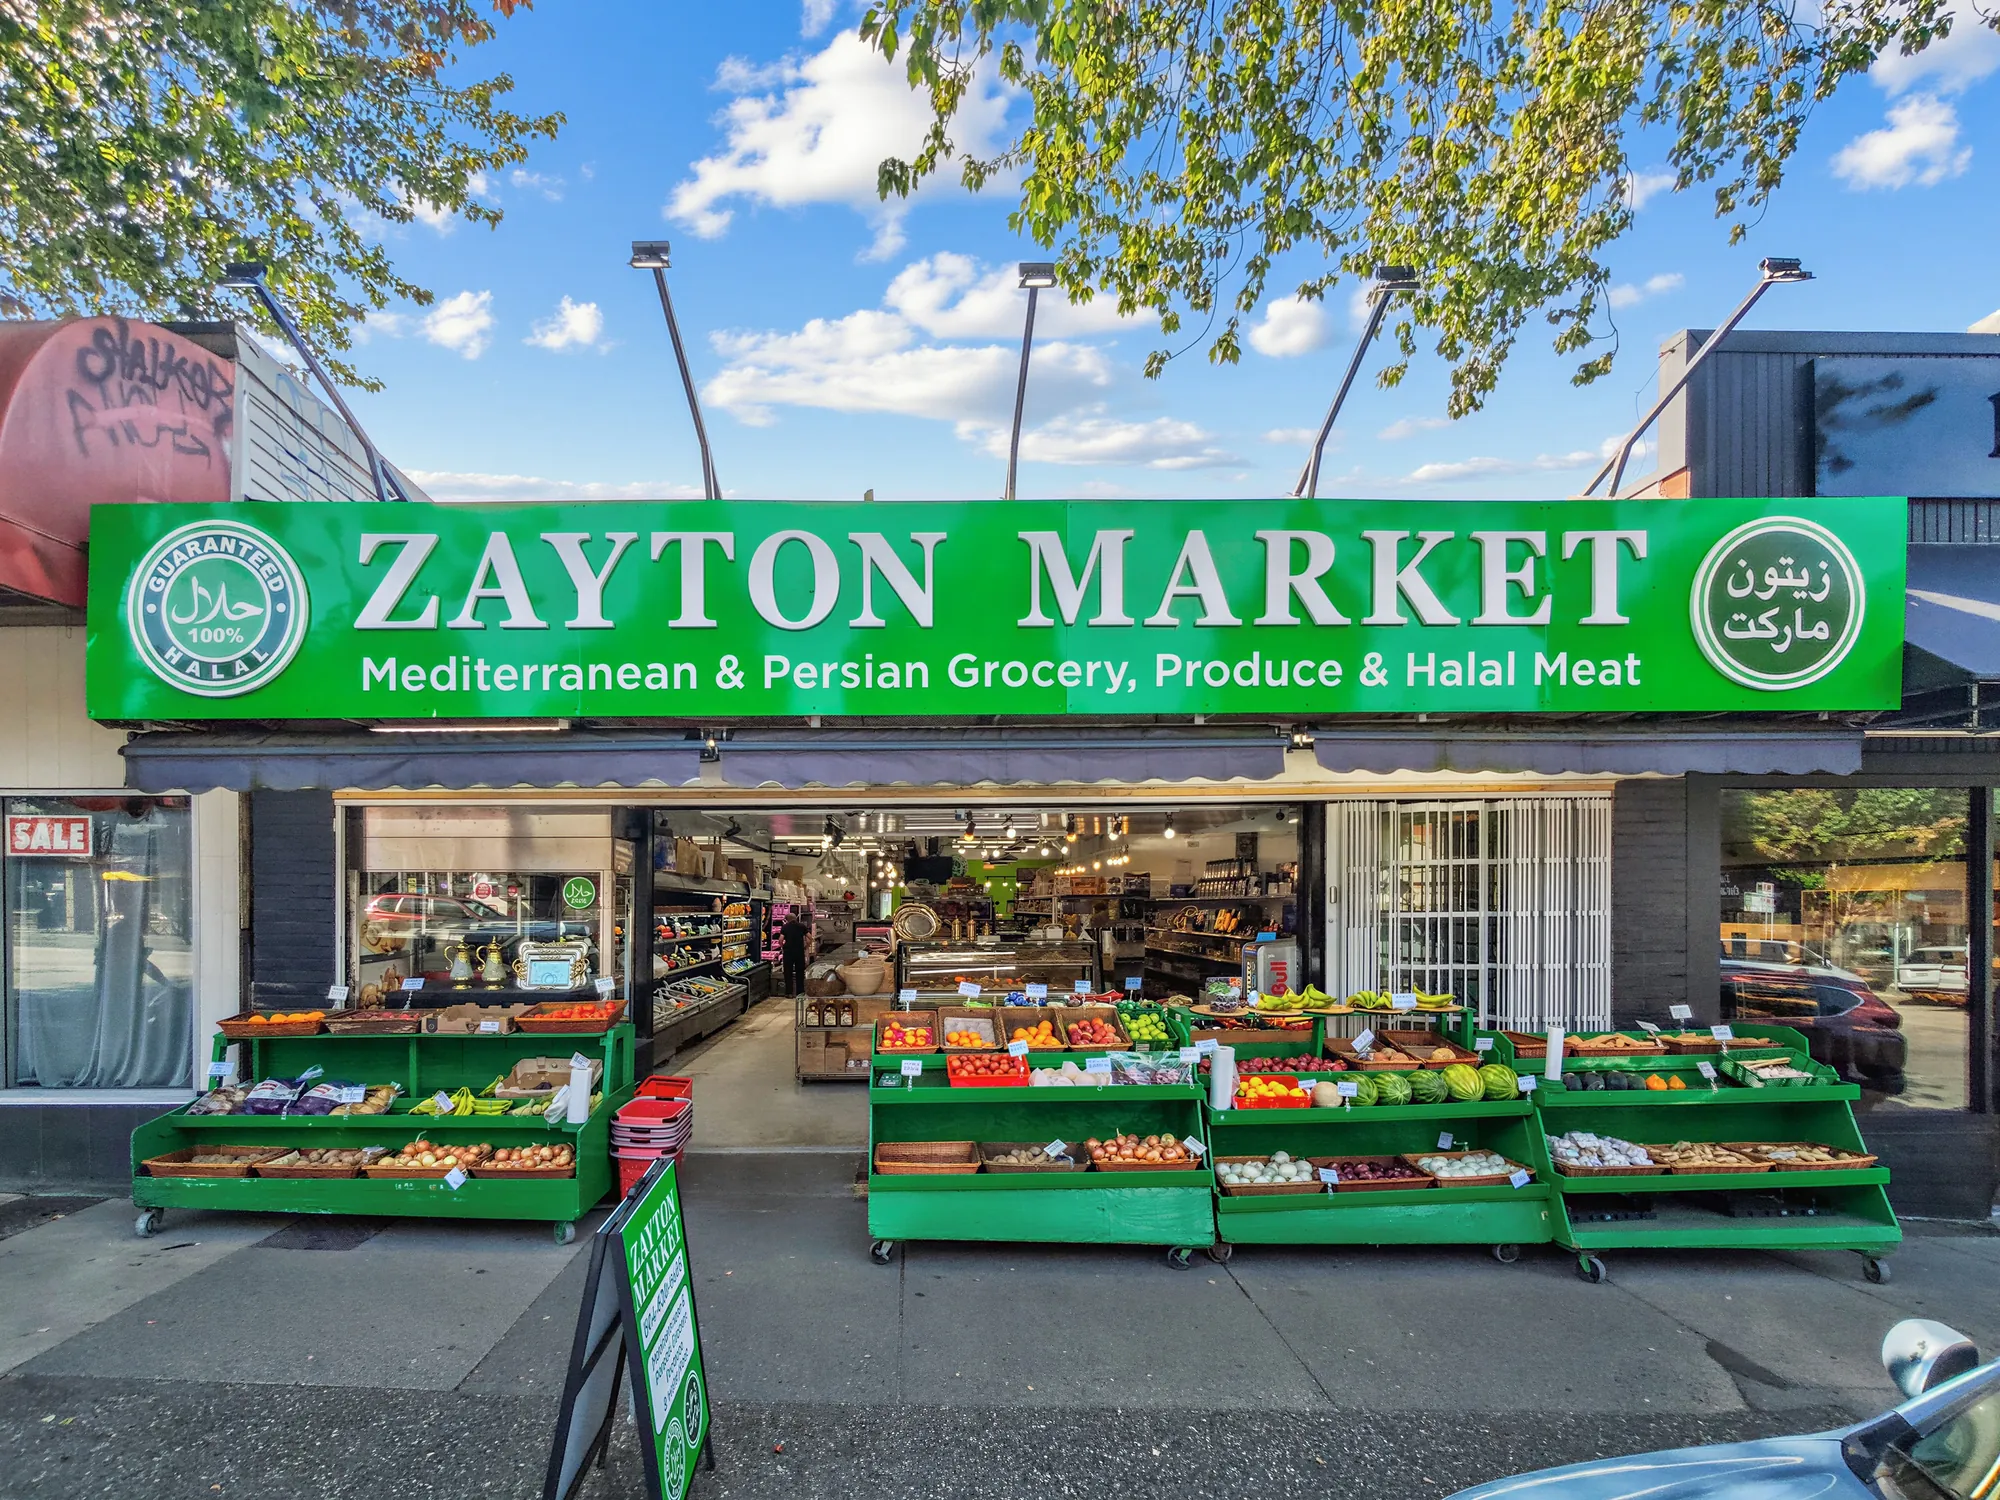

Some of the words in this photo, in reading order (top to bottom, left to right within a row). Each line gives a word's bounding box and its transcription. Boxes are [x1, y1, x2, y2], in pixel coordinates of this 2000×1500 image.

[149, 536, 286, 593] GUARANTEED
[354, 529, 947, 629] ZAYTON
[1017, 529, 1648, 626] MARKET
[171, 576, 264, 625] حلال
[188, 627, 244, 643] 100%
[164, 645, 270, 679] HALAL
[363, 655, 697, 692] Mediterranean
[716, 655, 745, 689] &
[764, 653, 929, 689] Persian
[948, 653, 1136, 694] Grocery,
[1156, 651, 1343, 687] Produce
[1360, 652, 1388, 687] &
[1407, 651, 1515, 687] Halal
[1535, 652, 1641, 686] Meat
[15, 822, 85, 850] SALE
[1270, 961, 1288, 996] Bull
[630, 1188, 676, 1279] ZAYTON
[633, 1215, 681, 1314] MARKET
